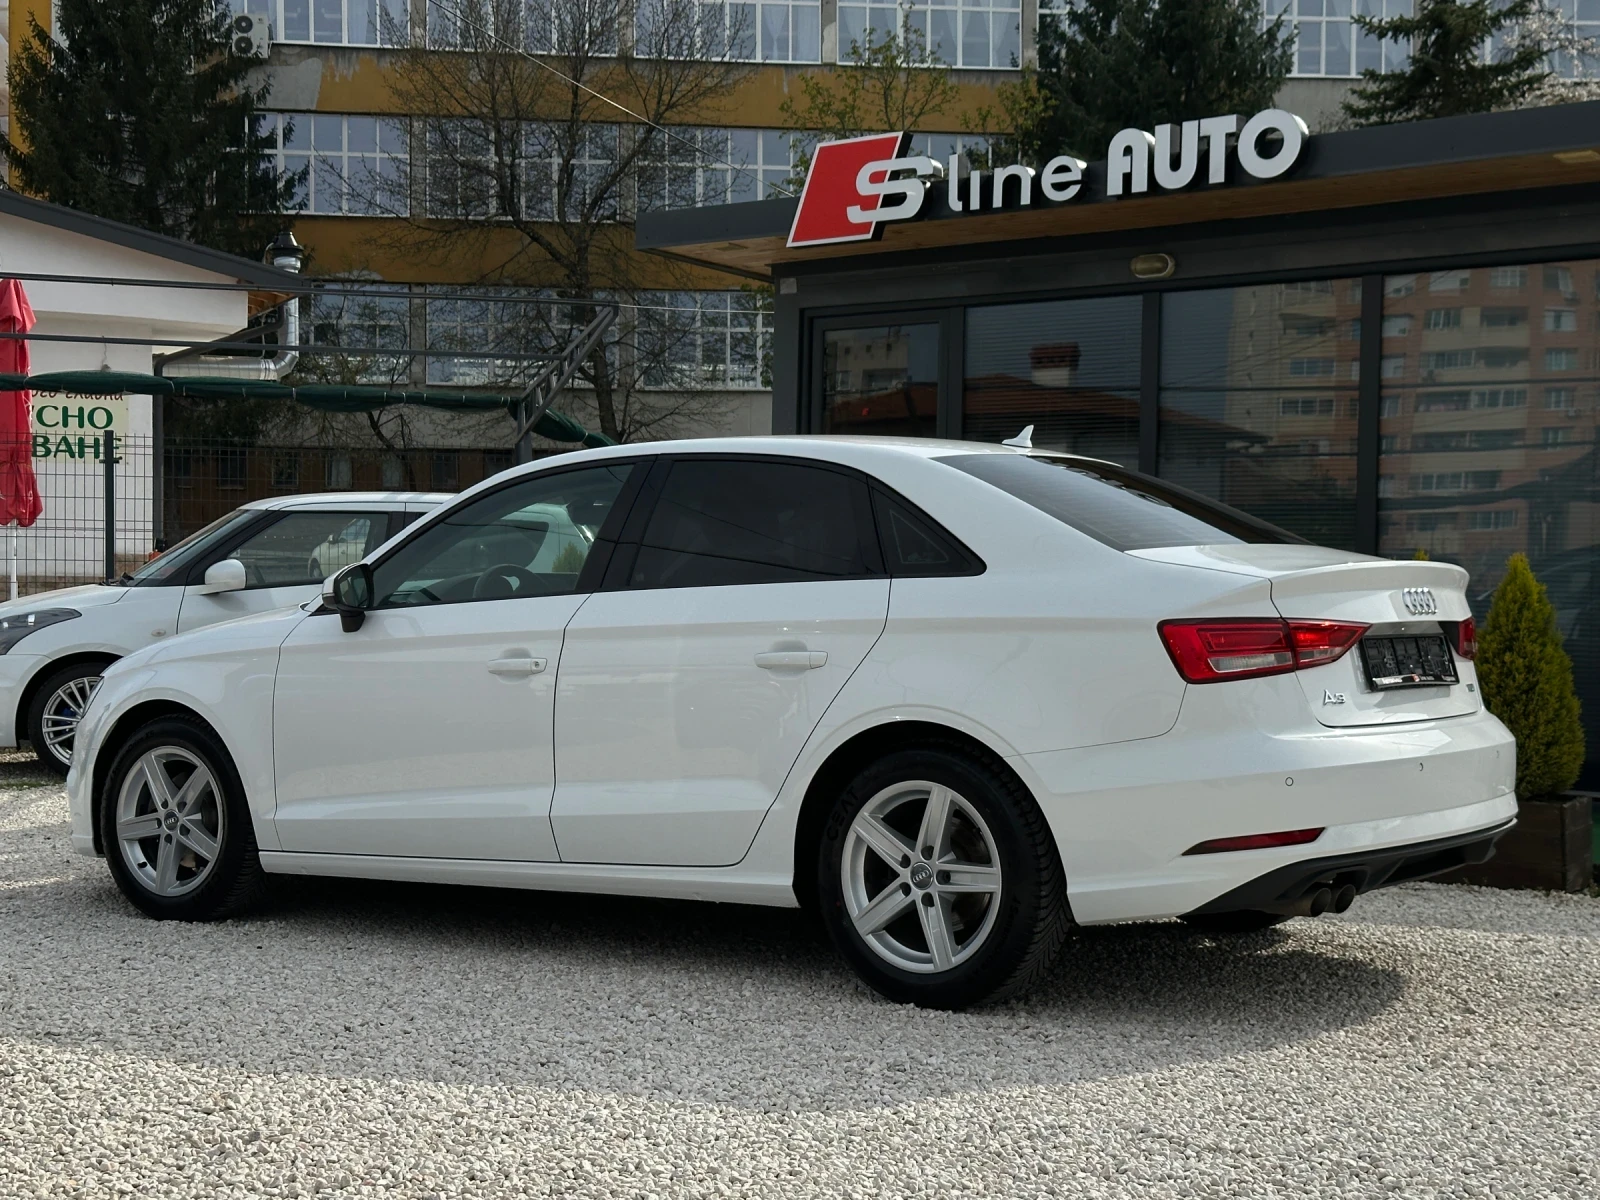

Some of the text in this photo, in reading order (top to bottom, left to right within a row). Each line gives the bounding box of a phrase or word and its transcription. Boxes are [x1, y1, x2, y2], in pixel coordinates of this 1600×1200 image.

[948, 153, 1083, 212] line
[1106, 108, 1303, 196] AUTO
[1323, 689, 1345, 706] A3
